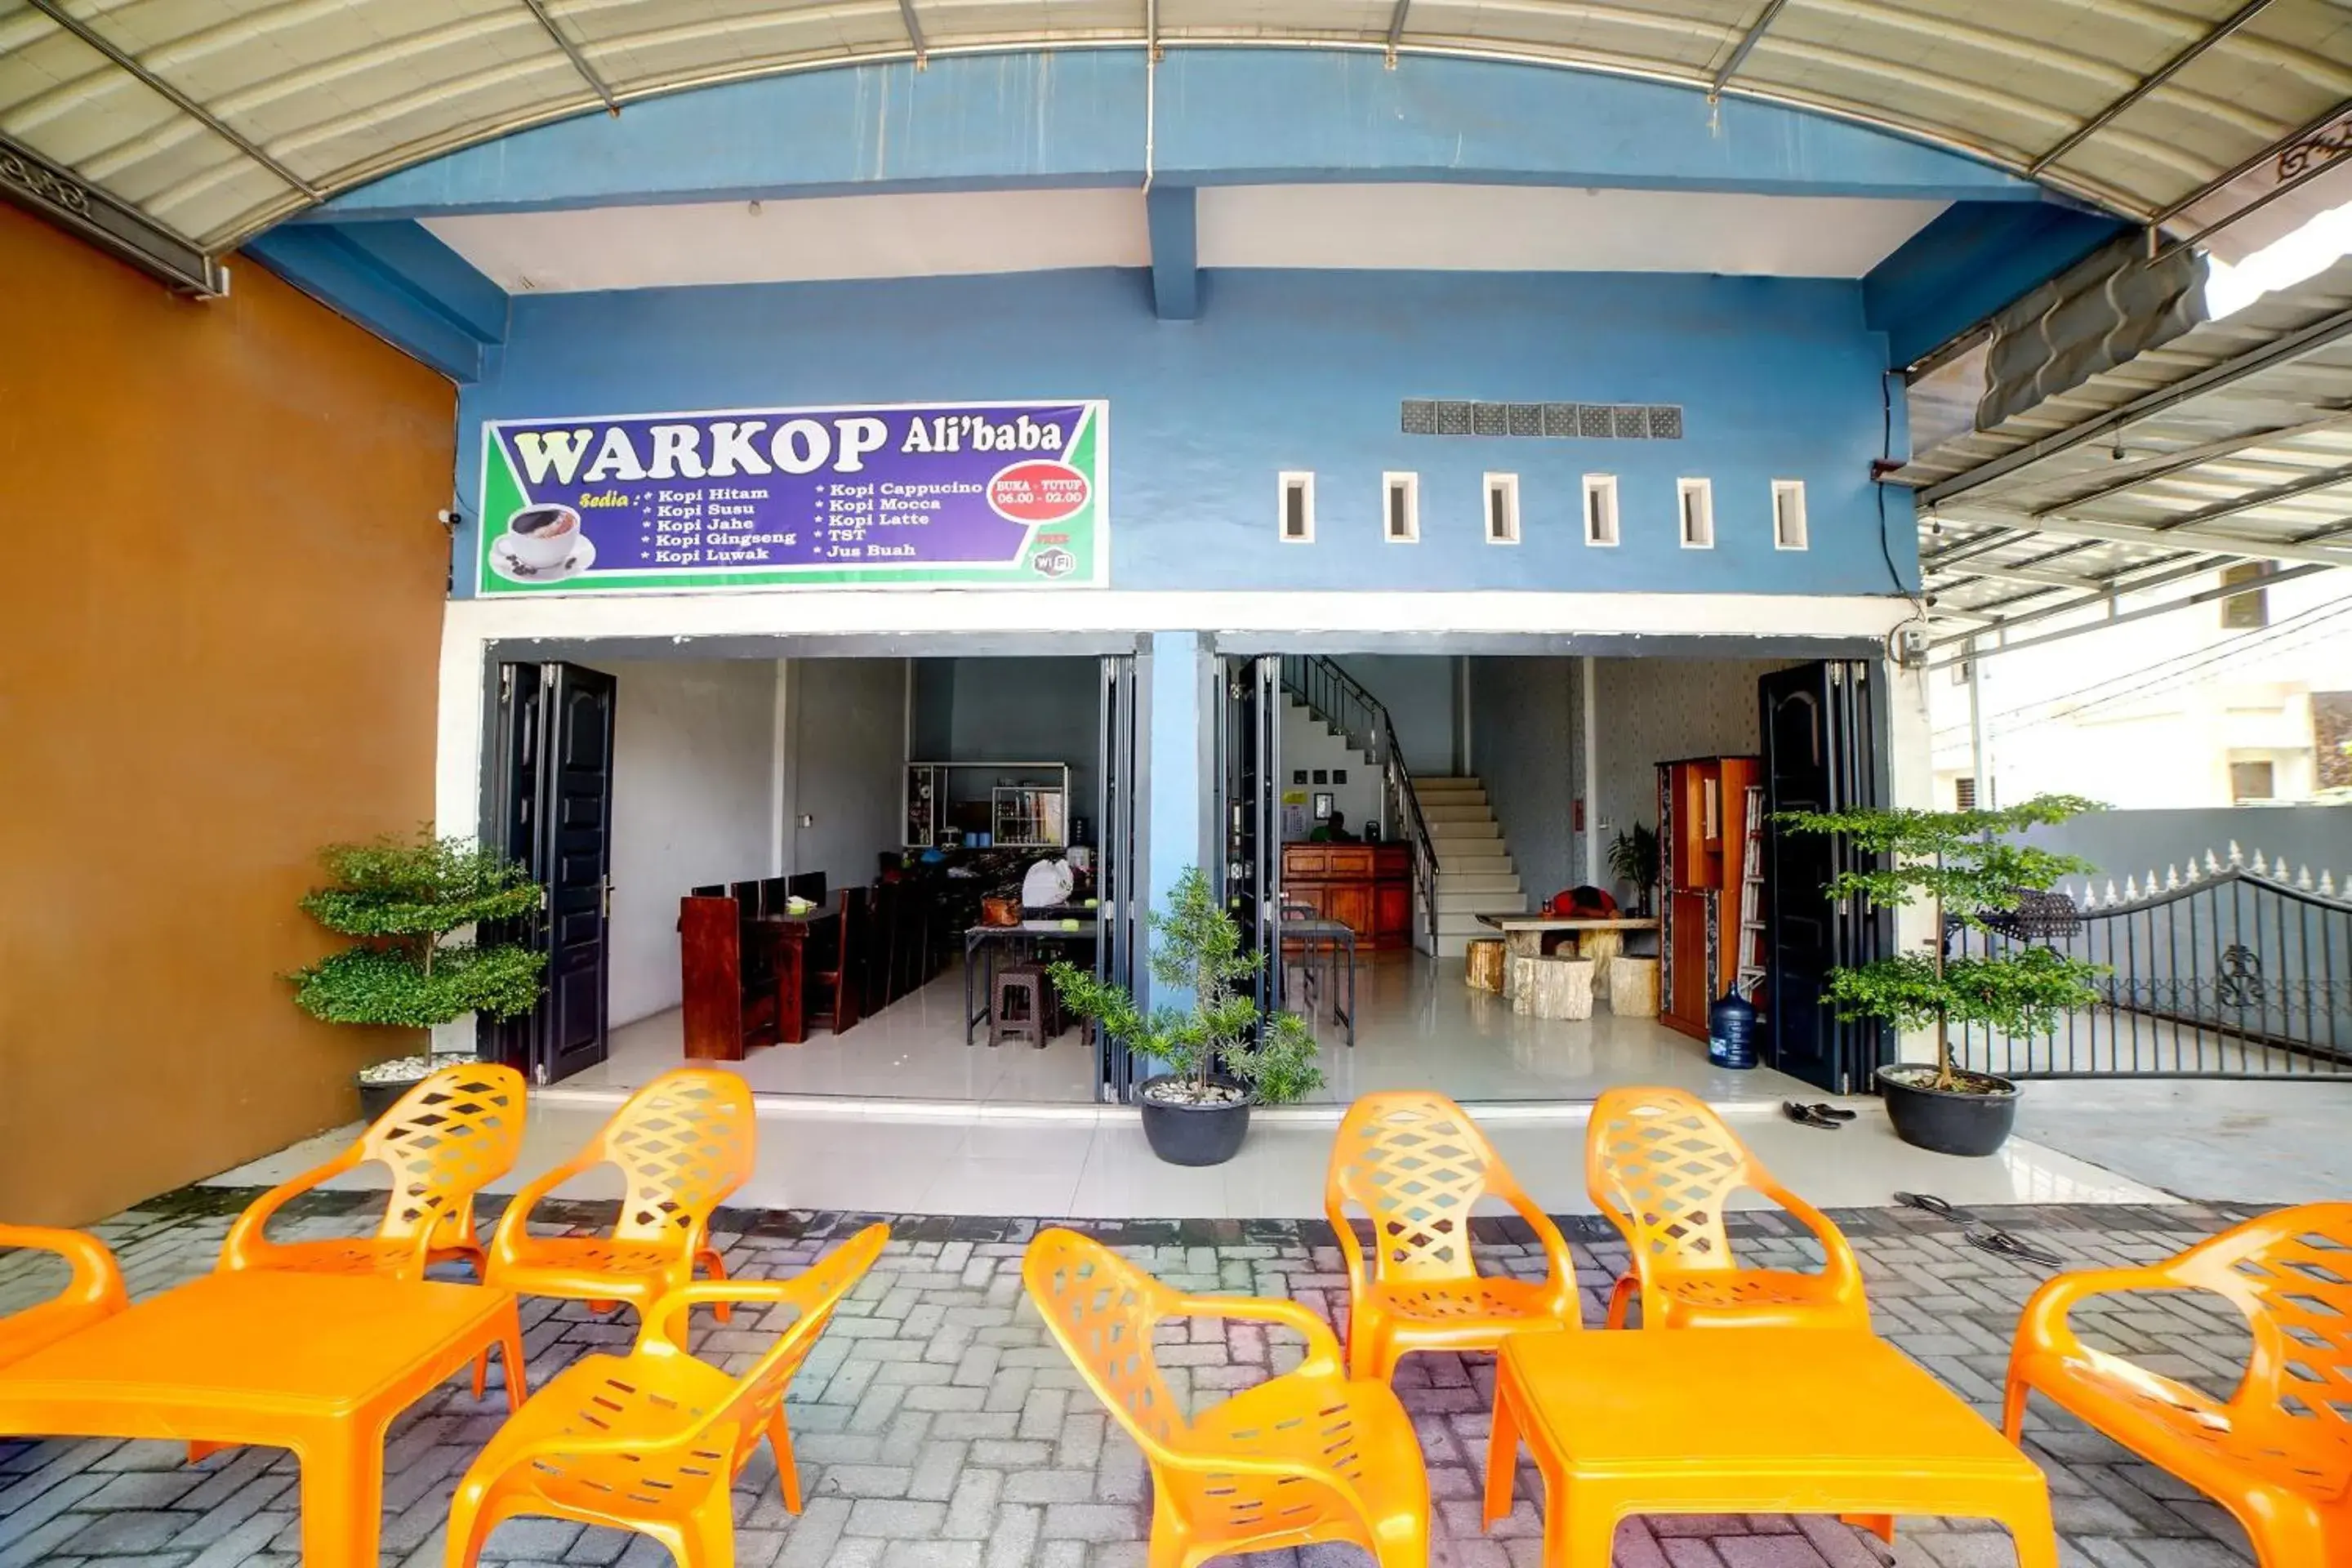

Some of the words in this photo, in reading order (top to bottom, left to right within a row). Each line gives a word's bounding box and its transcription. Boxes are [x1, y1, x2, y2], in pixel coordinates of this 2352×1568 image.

[514, 417, 889, 485] WARKOP
[658, 491, 702, 504] Kopi
[709, 489, 768, 501] Hitam
[830, 483, 875, 498] Kopi
[880, 481, 982, 497] Cappucino
[997, 492, 1034, 503] 06.00
[579, 490, 628, 508] Sedia
[830, 498, 874, 514] Kopi
[880, 498, 941, 510] Mocca
[657, 506, 702, 519] Kopi
[708, 504, 755, 514] Susu
[657, 520, 702, 534] Kopi
[706, 519, 754, 530] Jahe
[828, 514, 873, 529] Kopi
[879, 513, 929, 525] Latte
[656, 534, 701, 549] Kopi
[706, 532, 797, 546] Gingseng
[828, 529, 866, 541] TST
[655, 550, 700, 564] Kopi
[706, 548, 769, 561] Luwak
[826, 546, 861, 558] Jus
[867, 544, 915, 556] Buah
